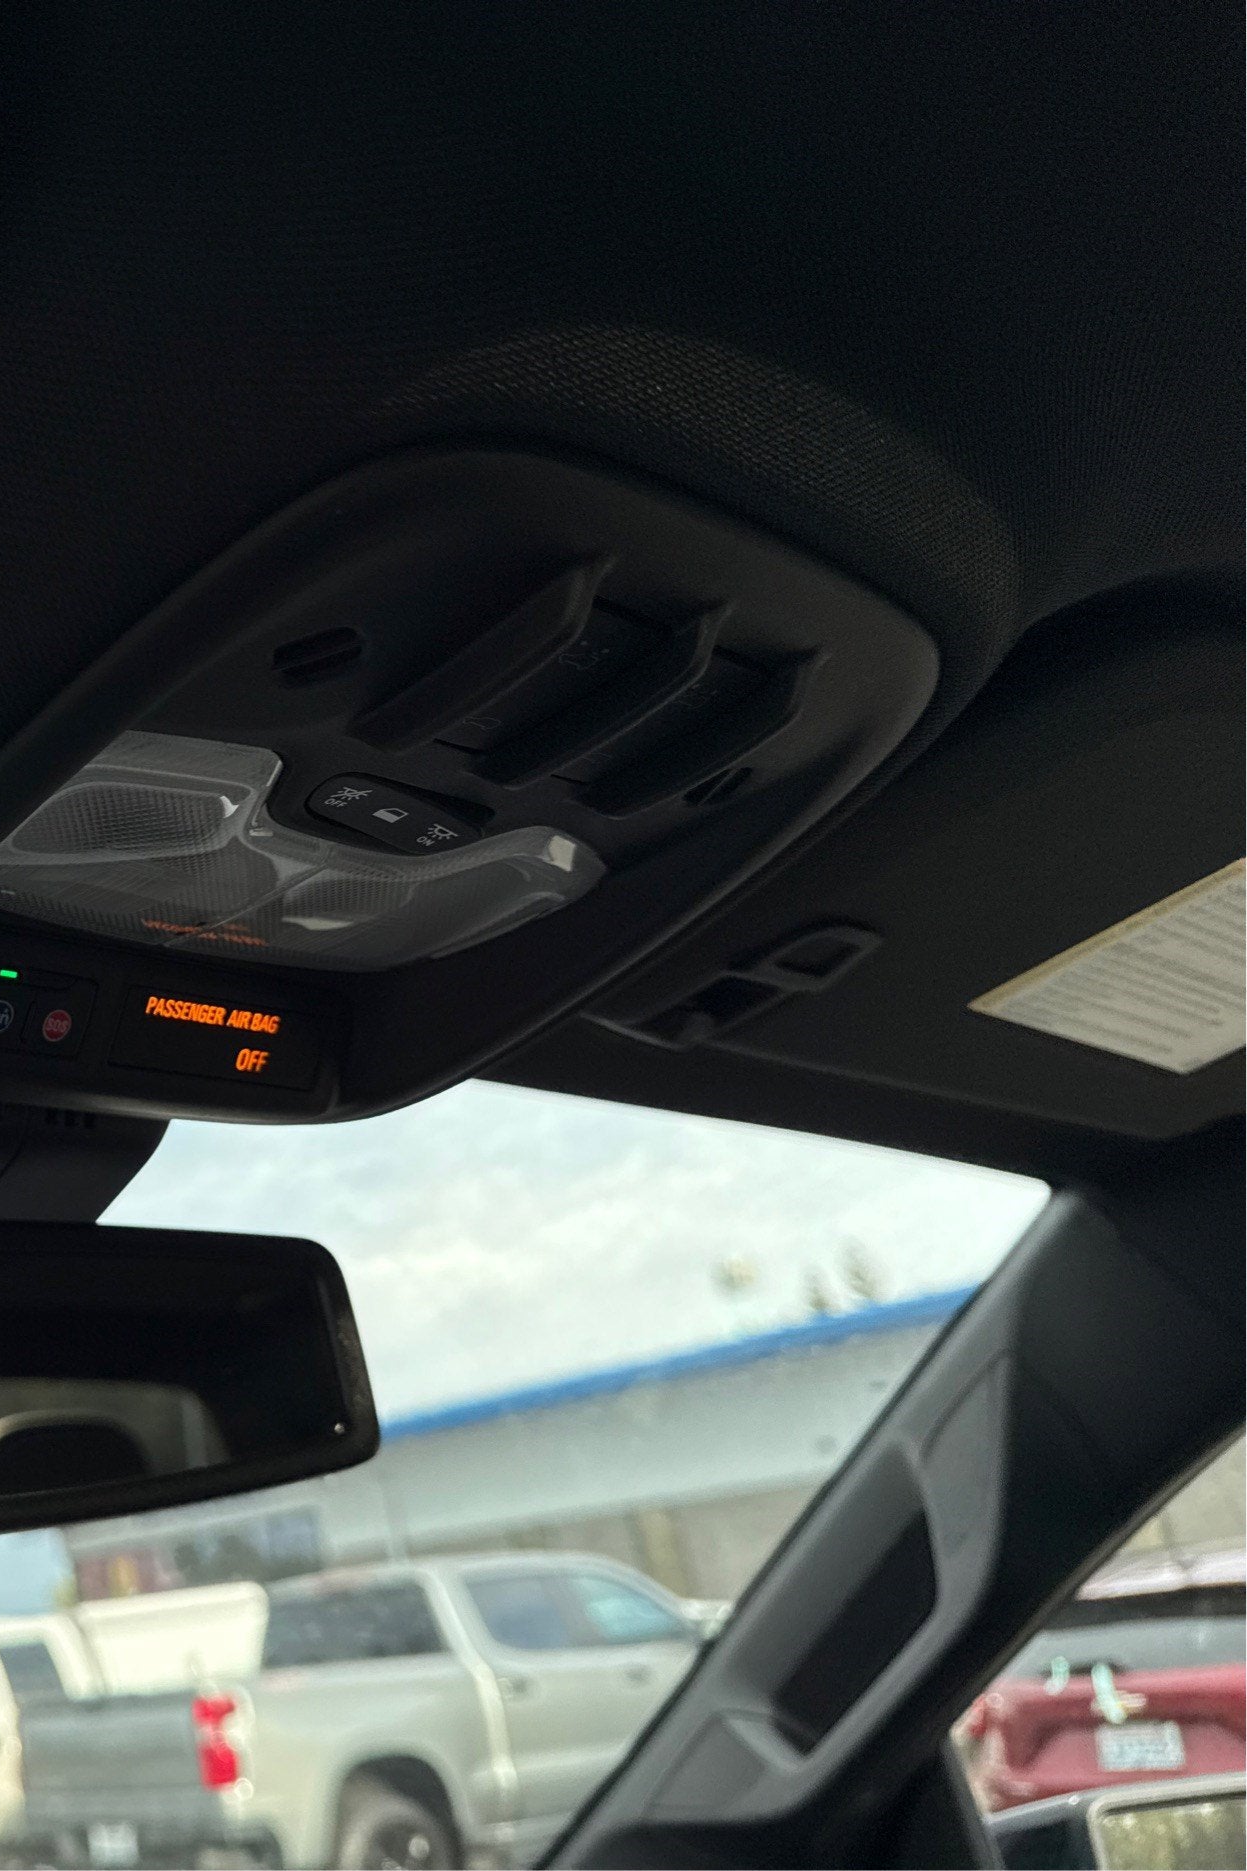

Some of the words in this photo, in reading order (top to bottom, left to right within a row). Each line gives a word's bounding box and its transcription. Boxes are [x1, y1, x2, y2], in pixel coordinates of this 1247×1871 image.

[323, 797, 348, 808] OFF
[416, 836, 436, 847] ON
[145, 996, 227, 1026] PASSENGER
[226, 1009, 252, 1030] AIR
[250, 1013, 281, 1034] BAG
[45, 1017, 69, 1033] SOS
[235, 1048, 270, 1073] OFF
